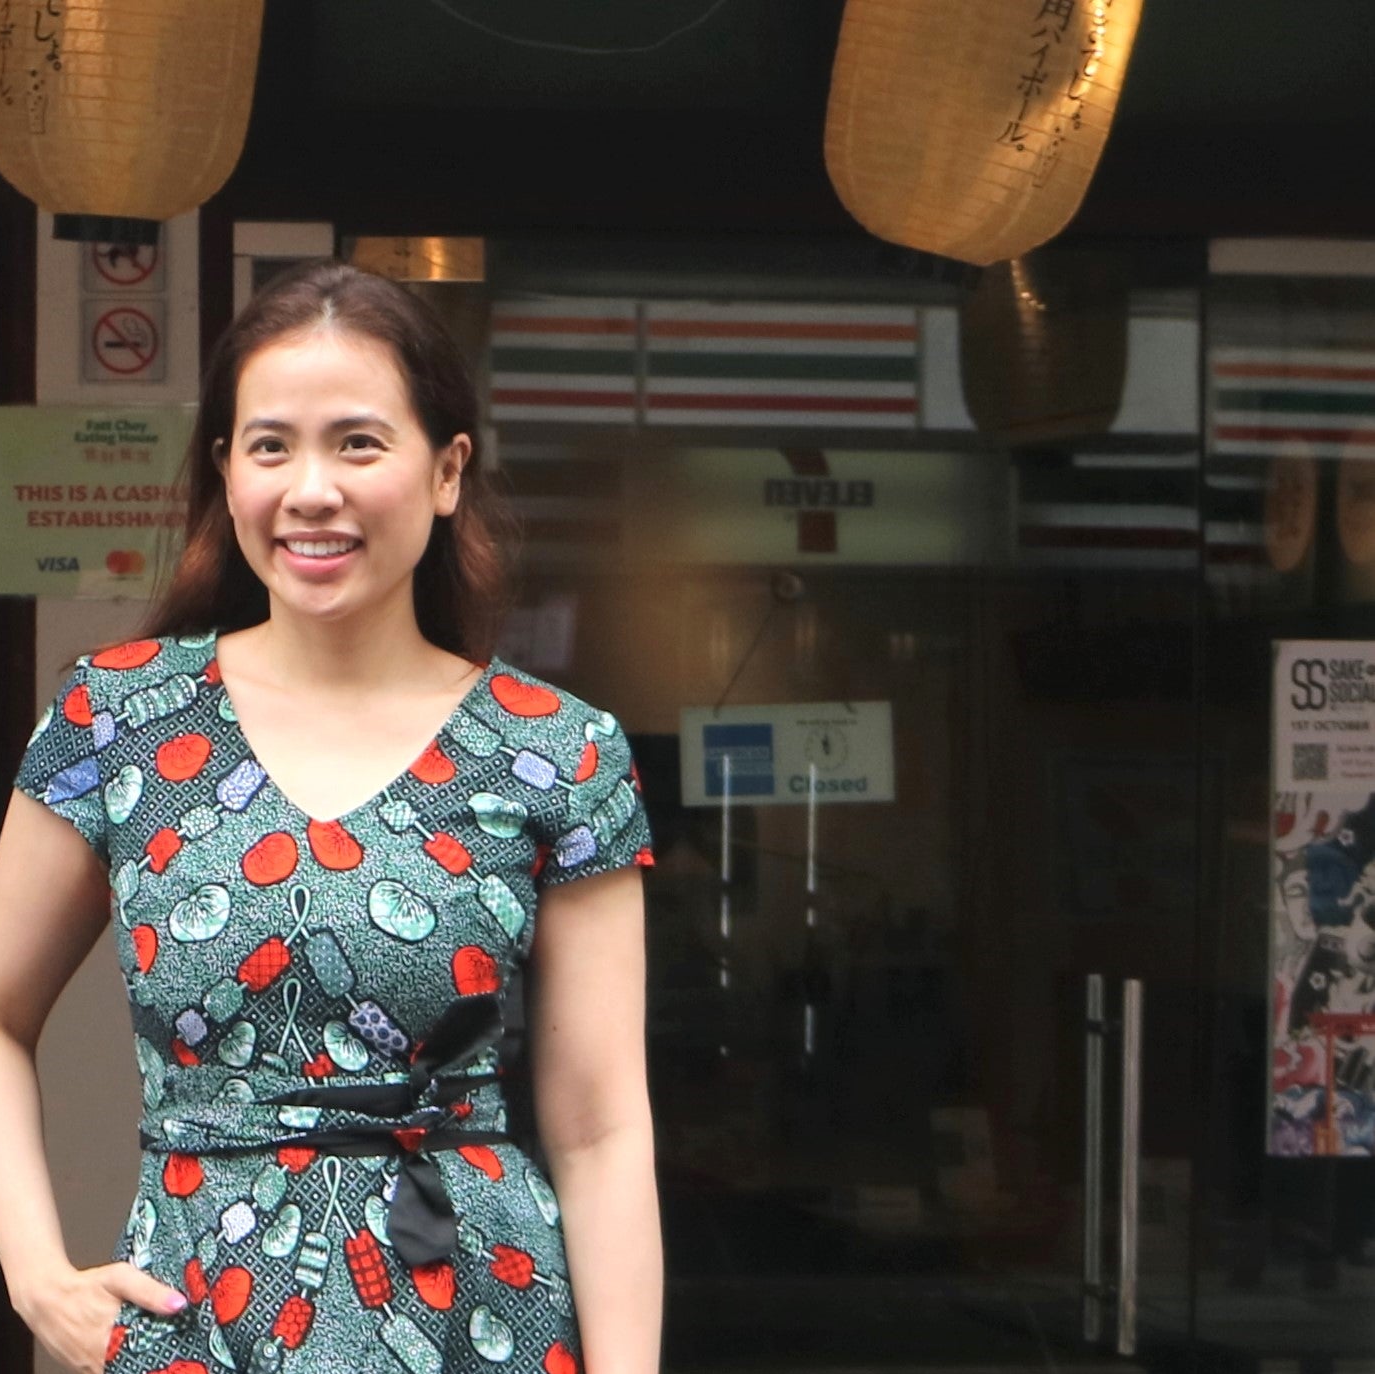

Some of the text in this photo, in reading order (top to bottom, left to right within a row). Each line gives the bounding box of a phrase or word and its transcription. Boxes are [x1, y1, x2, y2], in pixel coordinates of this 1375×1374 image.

[74, 431, 159, 446] Eating House
[14, 485, 62, 501] THIS
[69, 485, 87, 501] IS
[93, 485, 107, 501] A
[36, 557, 80, 572] VISA
[1329, 659, 1364, 680] SAKE
[1313, 720, 1369, 731] OCTOBER
[789, 775, 867, 795] Closed
